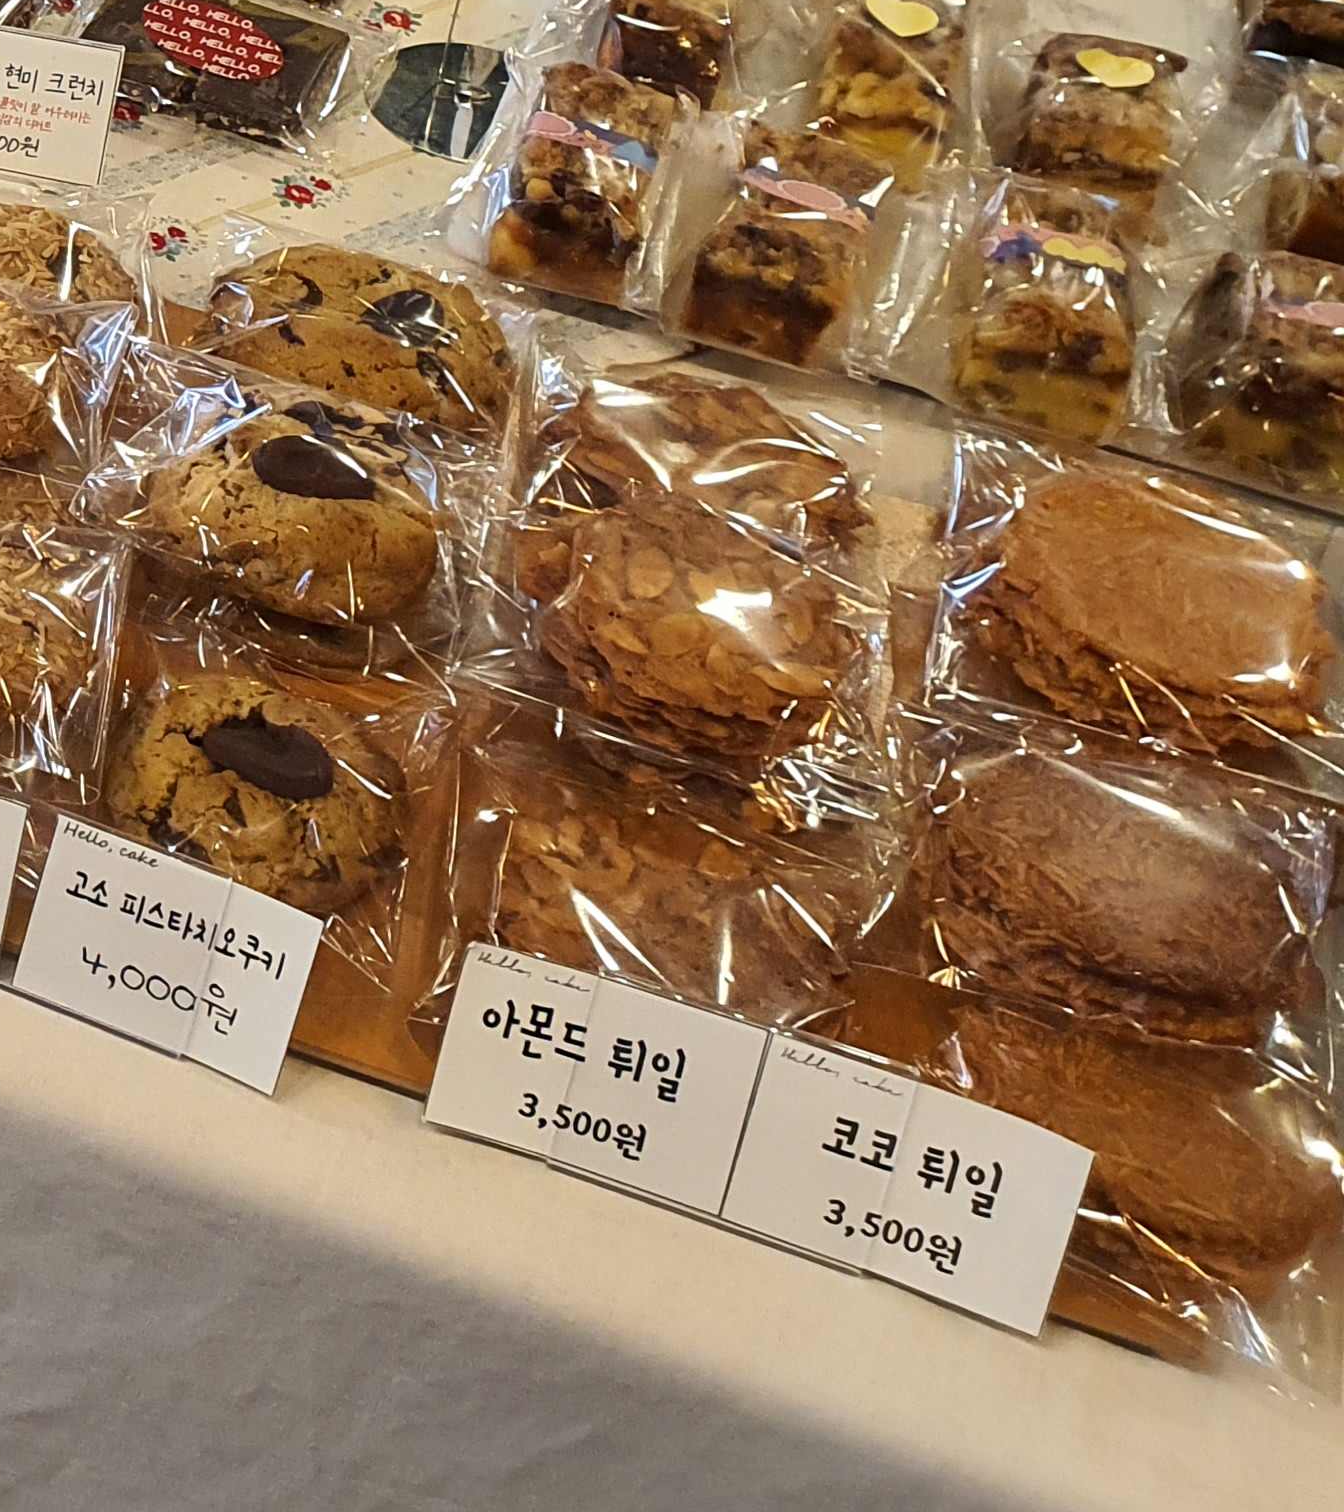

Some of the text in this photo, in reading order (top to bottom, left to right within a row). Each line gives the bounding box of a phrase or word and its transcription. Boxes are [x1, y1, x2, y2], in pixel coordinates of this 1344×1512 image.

[144, 19, 192, 42] HELLO,
[199, 36, 248, 59] HELLO,
[182, 16, 231, 39] HELLO,
[239, 33, 281, 51] HELL
[206, 9, 254, 32] HELLO,
[157, 38, 261, 76] HELLO, HELLO,
[4, 62, 39, 93] 현미
[44, 73, 104, 106] 크런치
[63, 822, 160, 869] Hello, cake
[66, 871, 109, 909] 고소
[81, 946, 238, 1035] 4,000원
[482, 999, 686, 1103] 아몬드 튀일
[518, 1092, 647, 1161] 3,500원
[821, 1117, 1003, 1219] 코코 튀일
[823, 1198, 962, 1275] 3,500원
